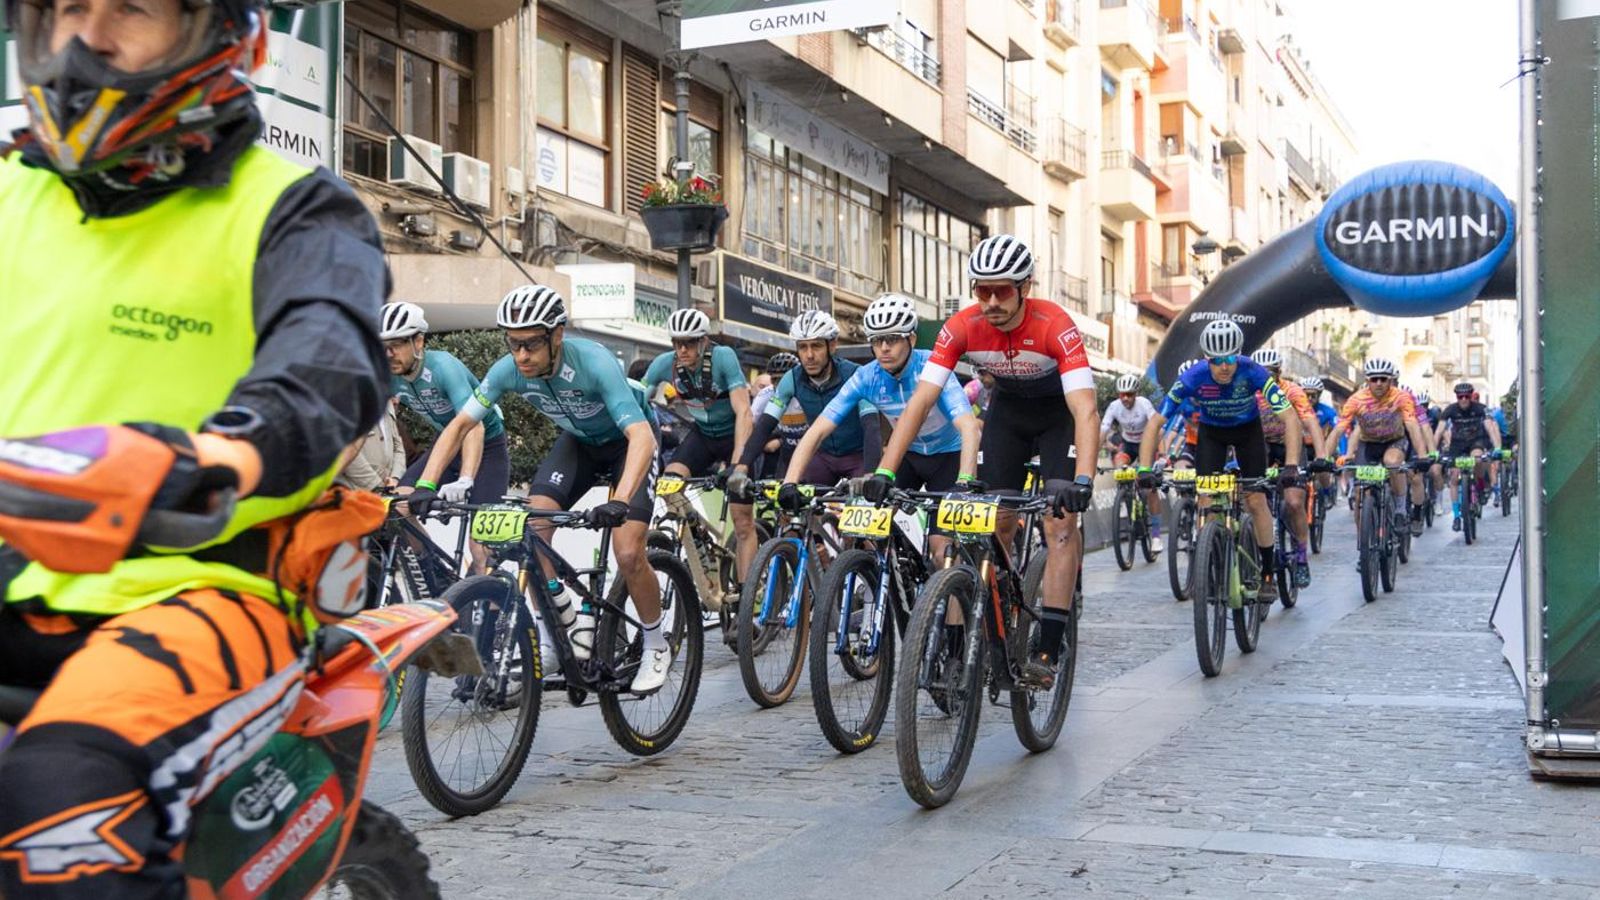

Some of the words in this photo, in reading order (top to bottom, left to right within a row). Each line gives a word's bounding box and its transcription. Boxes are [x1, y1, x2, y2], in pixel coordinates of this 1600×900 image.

[749, 10, 826, 32] GARMIN
[1335, 214, 1488, 245] GARMIN
[576, 284, 626, 297] TECNOCASA
[739, 274, 788, 307] VERÓNICA
[787, 288, 795, 309] Y
[796, 291, 820, 317] JESÚS
[112, 304, 213, 341] octagon
[1188, 310, 1257, 324] garmin.com
[1063, 331, 1079, 343] PYL
[476, 512, 521, 535] 337-1
[844, 509, 888, 531] 203-2
[943, 502, 991, 527] 203-1
